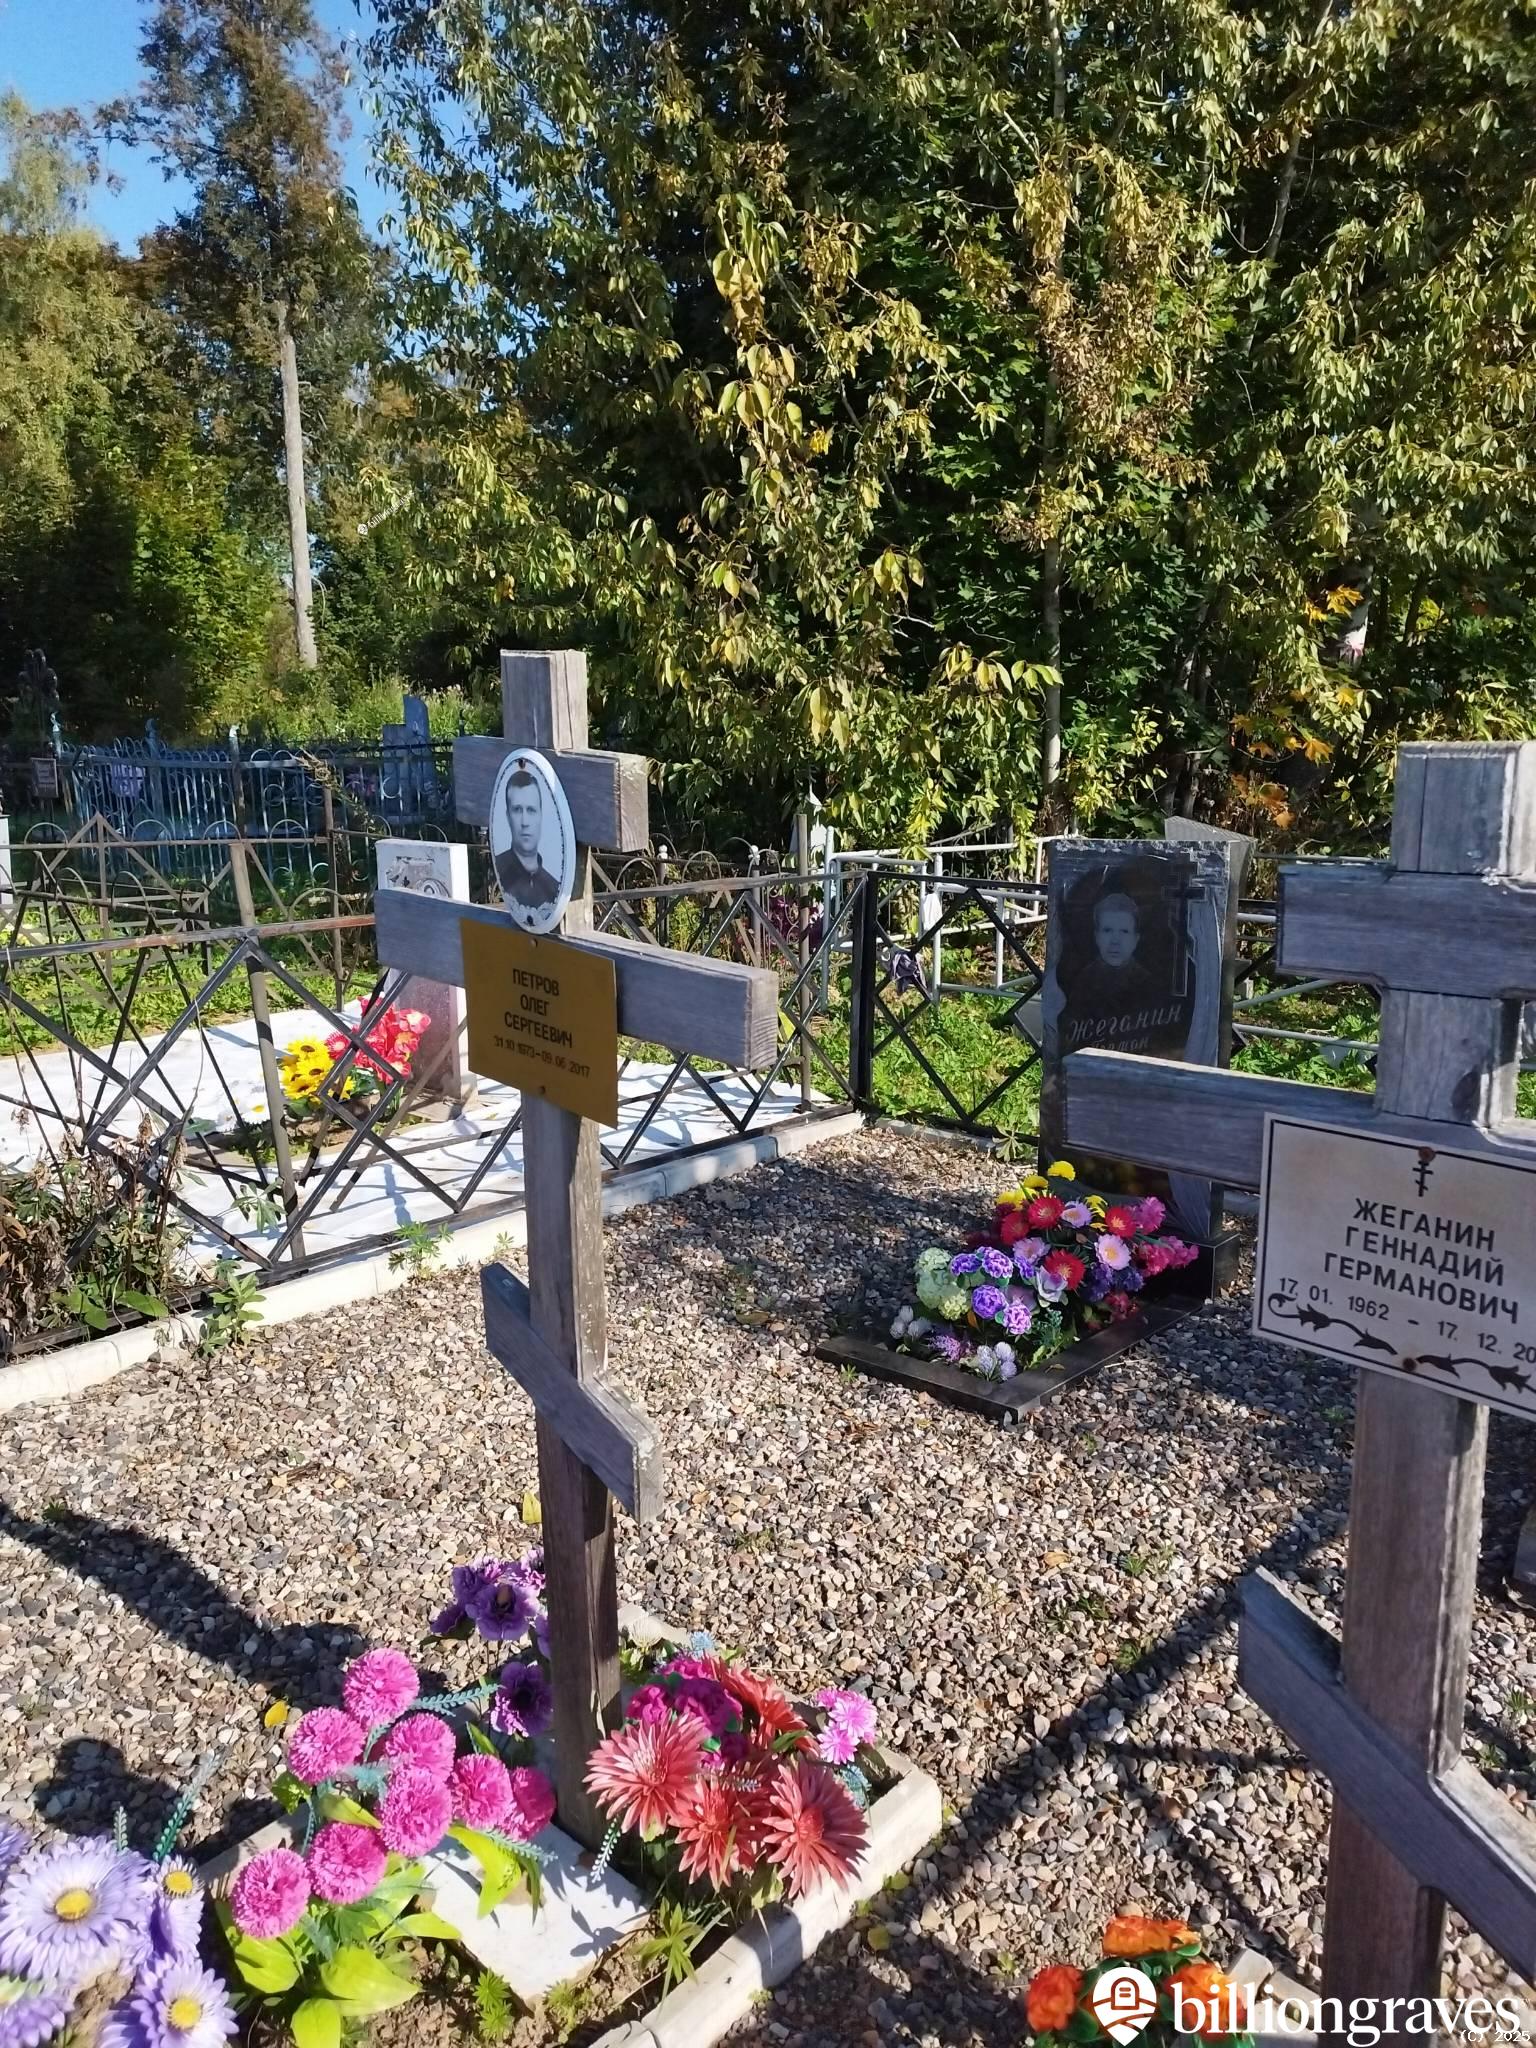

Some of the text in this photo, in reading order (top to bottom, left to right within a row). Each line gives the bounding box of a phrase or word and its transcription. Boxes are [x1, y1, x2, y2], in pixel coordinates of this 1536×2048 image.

[512, 968, 560, 997] ПЕТРОВ
[519, 994, 550, 1016] ОЛЕГ
[1070, 1004, 1182, 1041] Жеганин
[504, 1011, 573, 1048] СЕРГЕЕВИЧ
[1353, 1198, 1495, 1252] ЖЕГАНИН
[1345, 1226, 1505, 1287] ГЕННАДИЙ
[1324, 1252, 1519, 1324] ГЕРМАНОВИЧ
[1348, 1295, 1390, 1321] 1962
